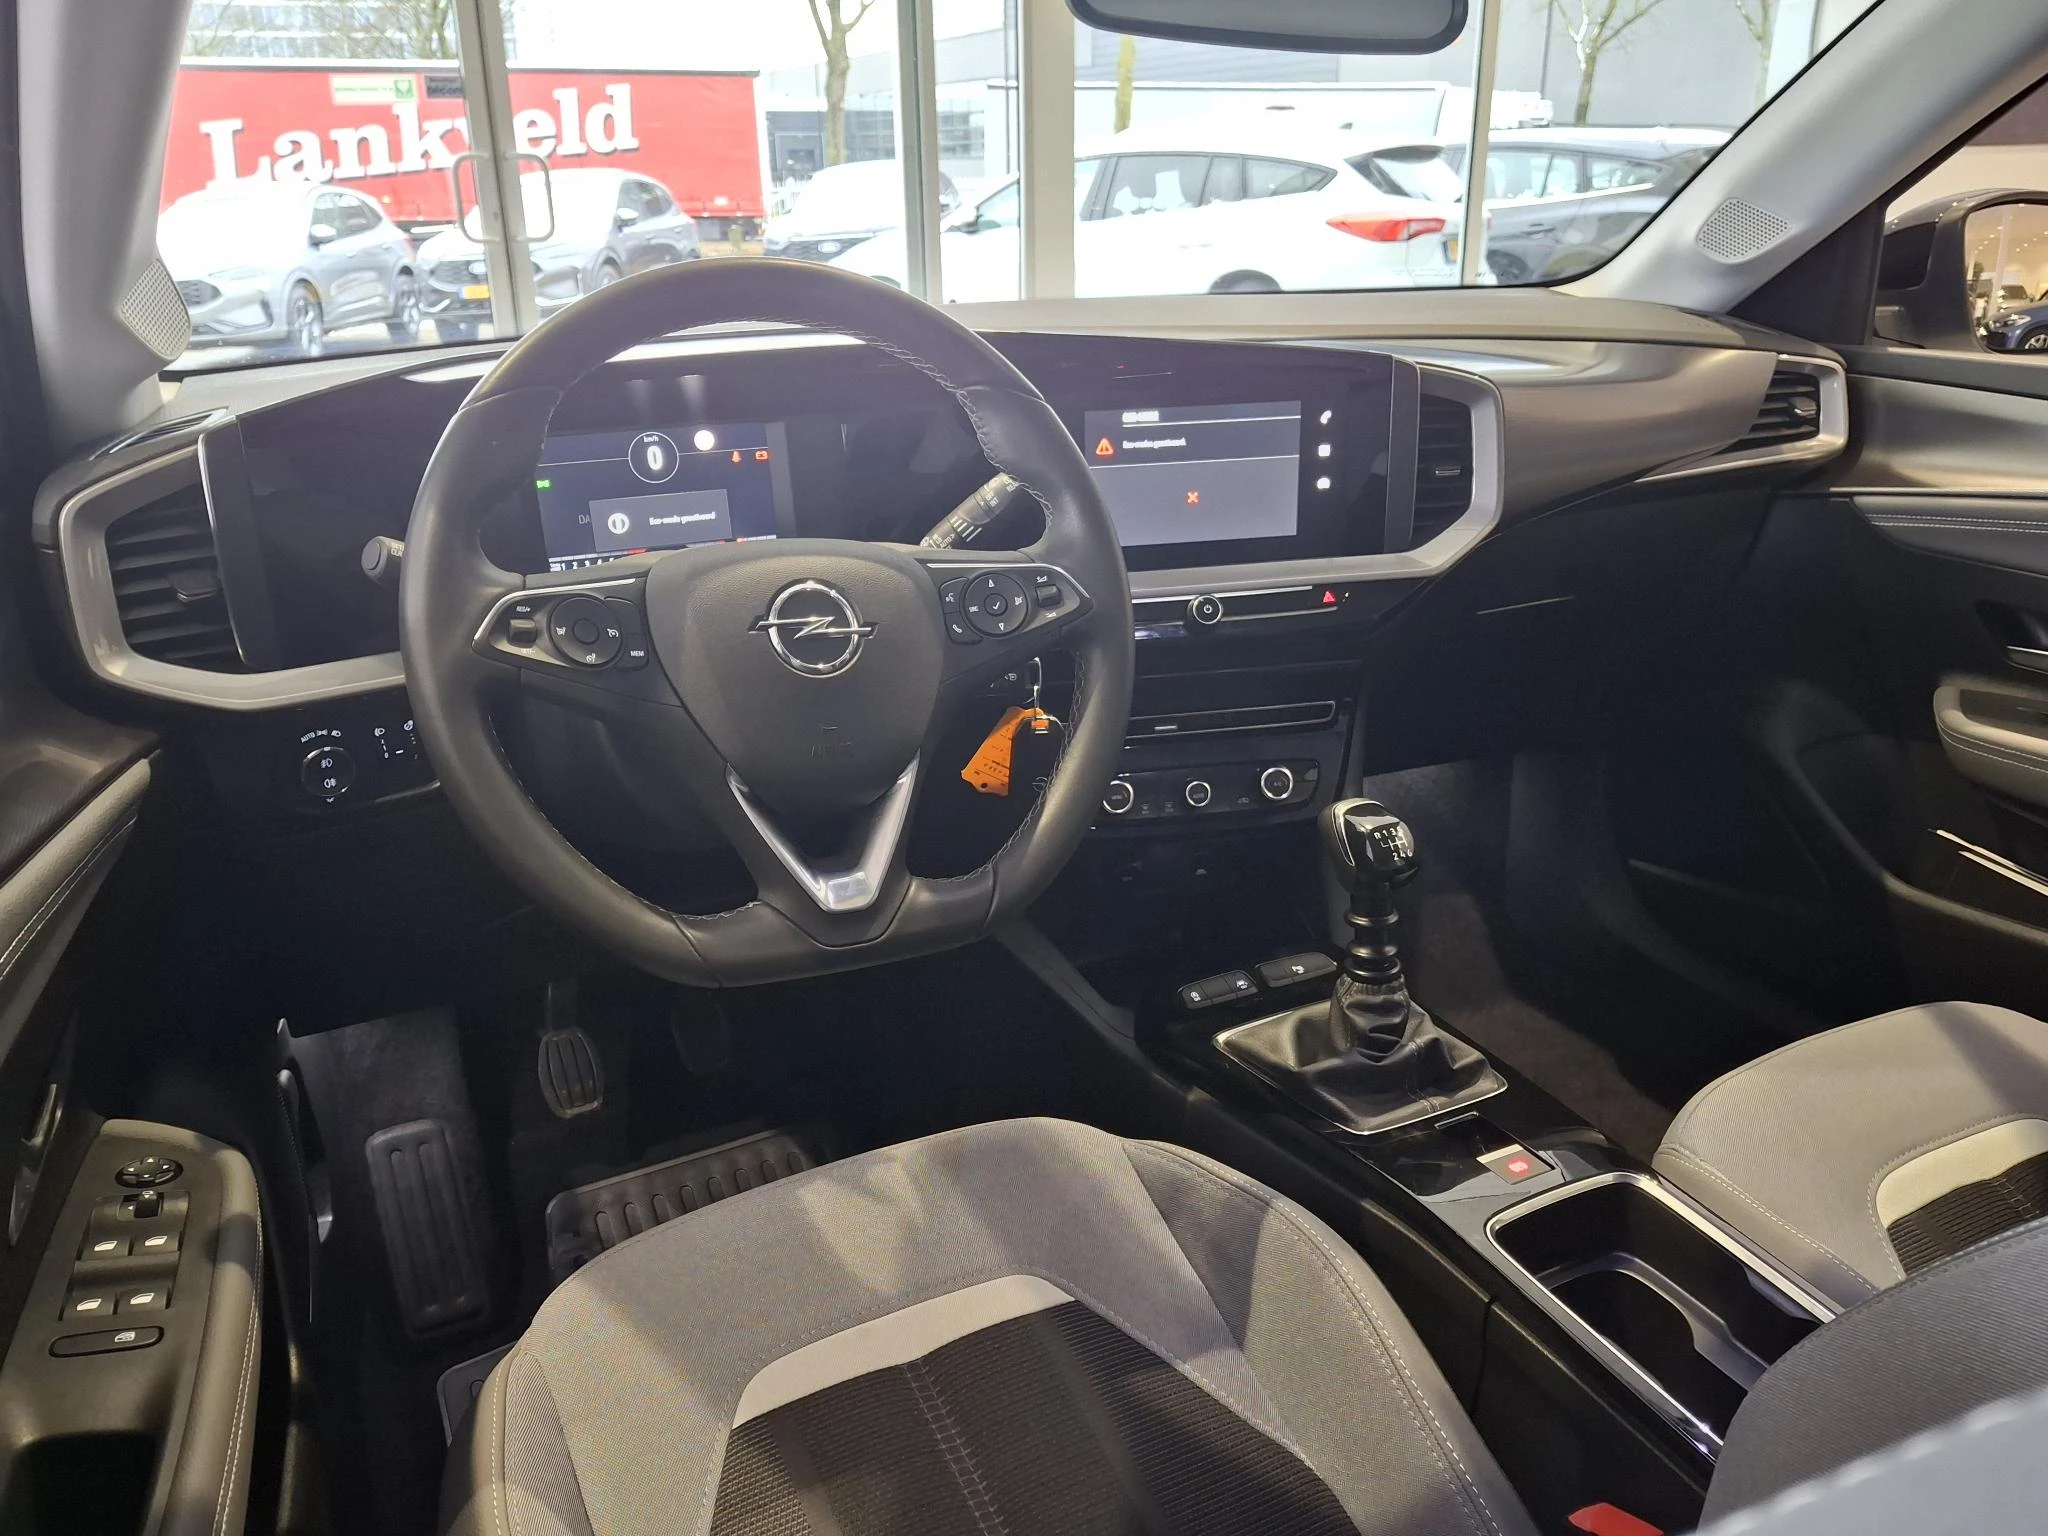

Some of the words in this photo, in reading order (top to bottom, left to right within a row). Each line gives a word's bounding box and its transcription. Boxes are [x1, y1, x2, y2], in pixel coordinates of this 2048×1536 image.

[643, 435, 660, 443] km/h
[647, 445, 663, 470] 0
[300, 731, 316, 743] AUTO
[1374, 832, 1381, 840] R
[1389, 828, 1396, 836] 3
[1392, 853, 1399, 861] 2
[1400, 850, 1406, 858] 4
